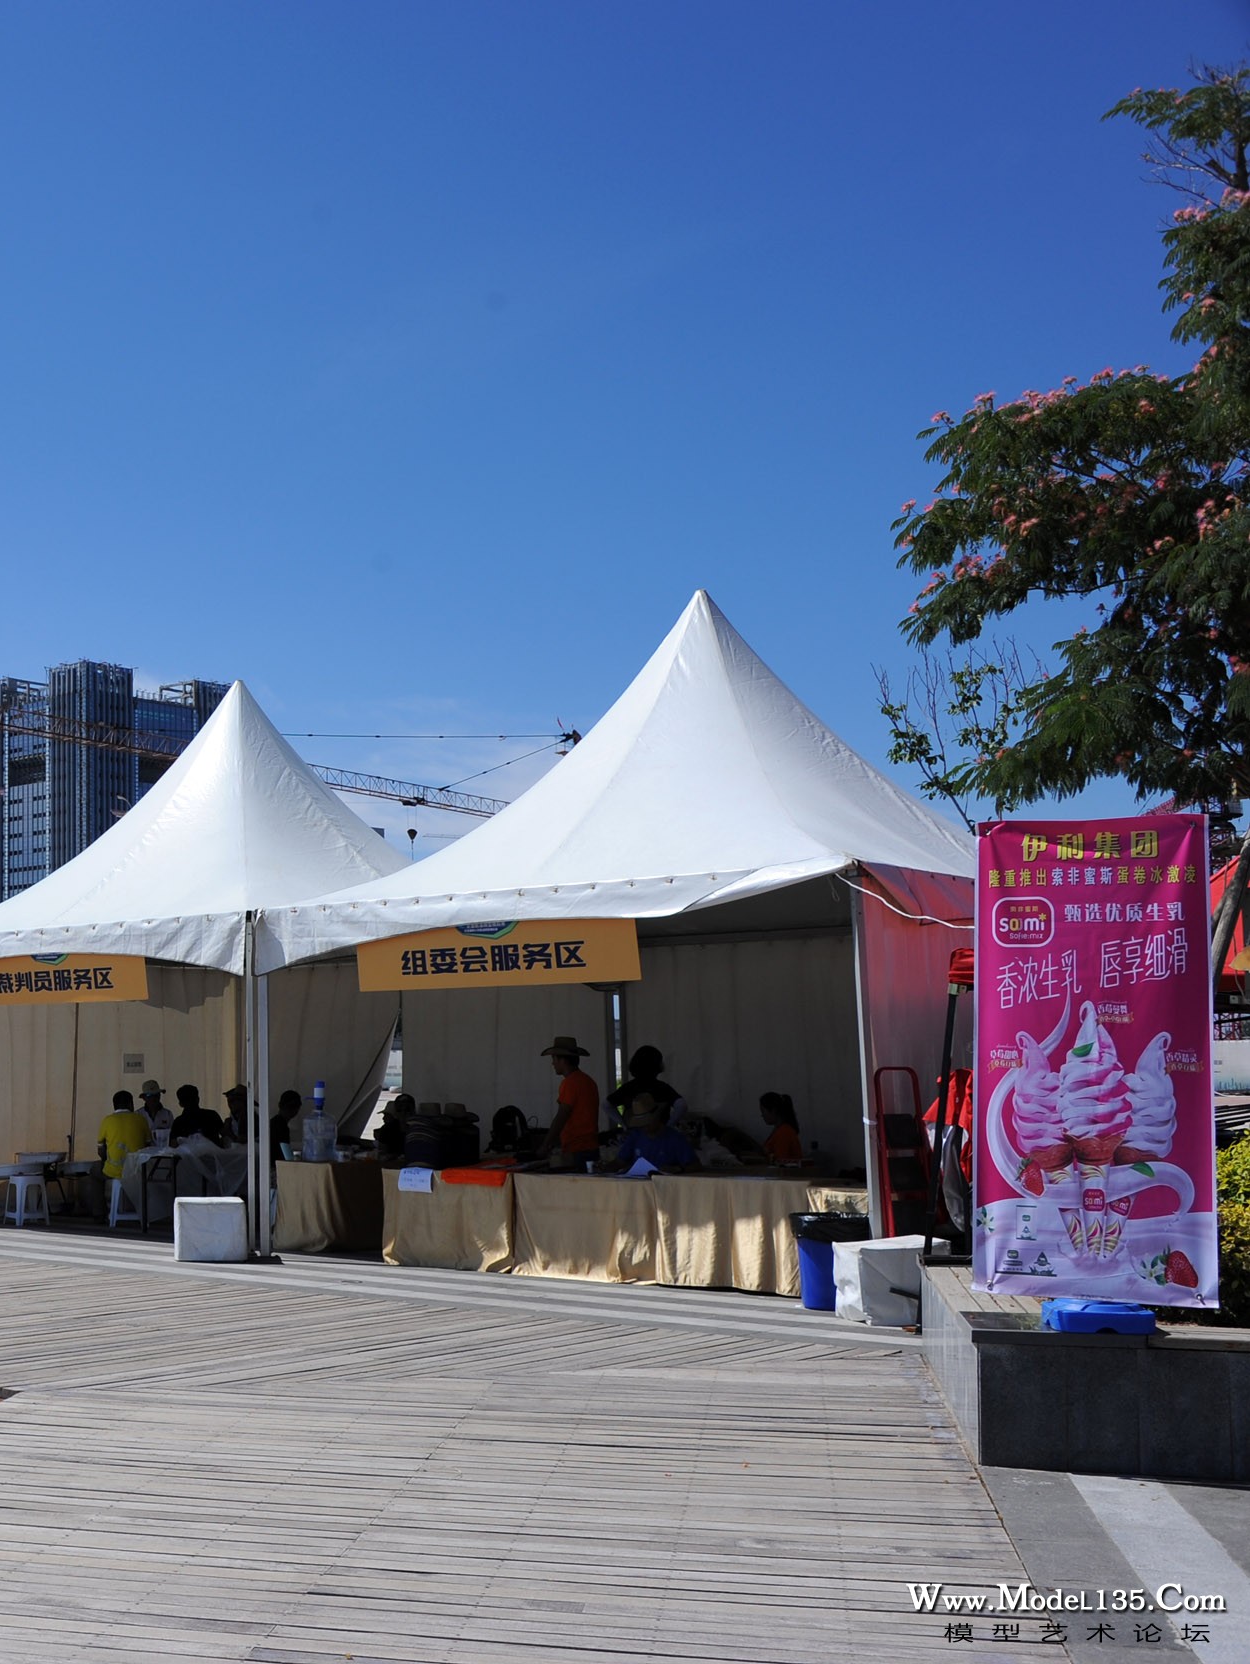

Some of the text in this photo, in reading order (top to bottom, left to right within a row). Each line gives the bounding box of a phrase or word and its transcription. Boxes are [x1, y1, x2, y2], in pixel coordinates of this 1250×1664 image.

[1020, 830, 1159, 862] 伊利集团
[988, 864, 1197, 889] 隆重推出索非蜜斯蛋卷冰激凌
[1064, 902, 1185, 922] 甄选优质生乳
[401, 940, 587, 975] 组委会服务区
[996, 927, 1188, 1009] 香浓生乳 唇享细滑
